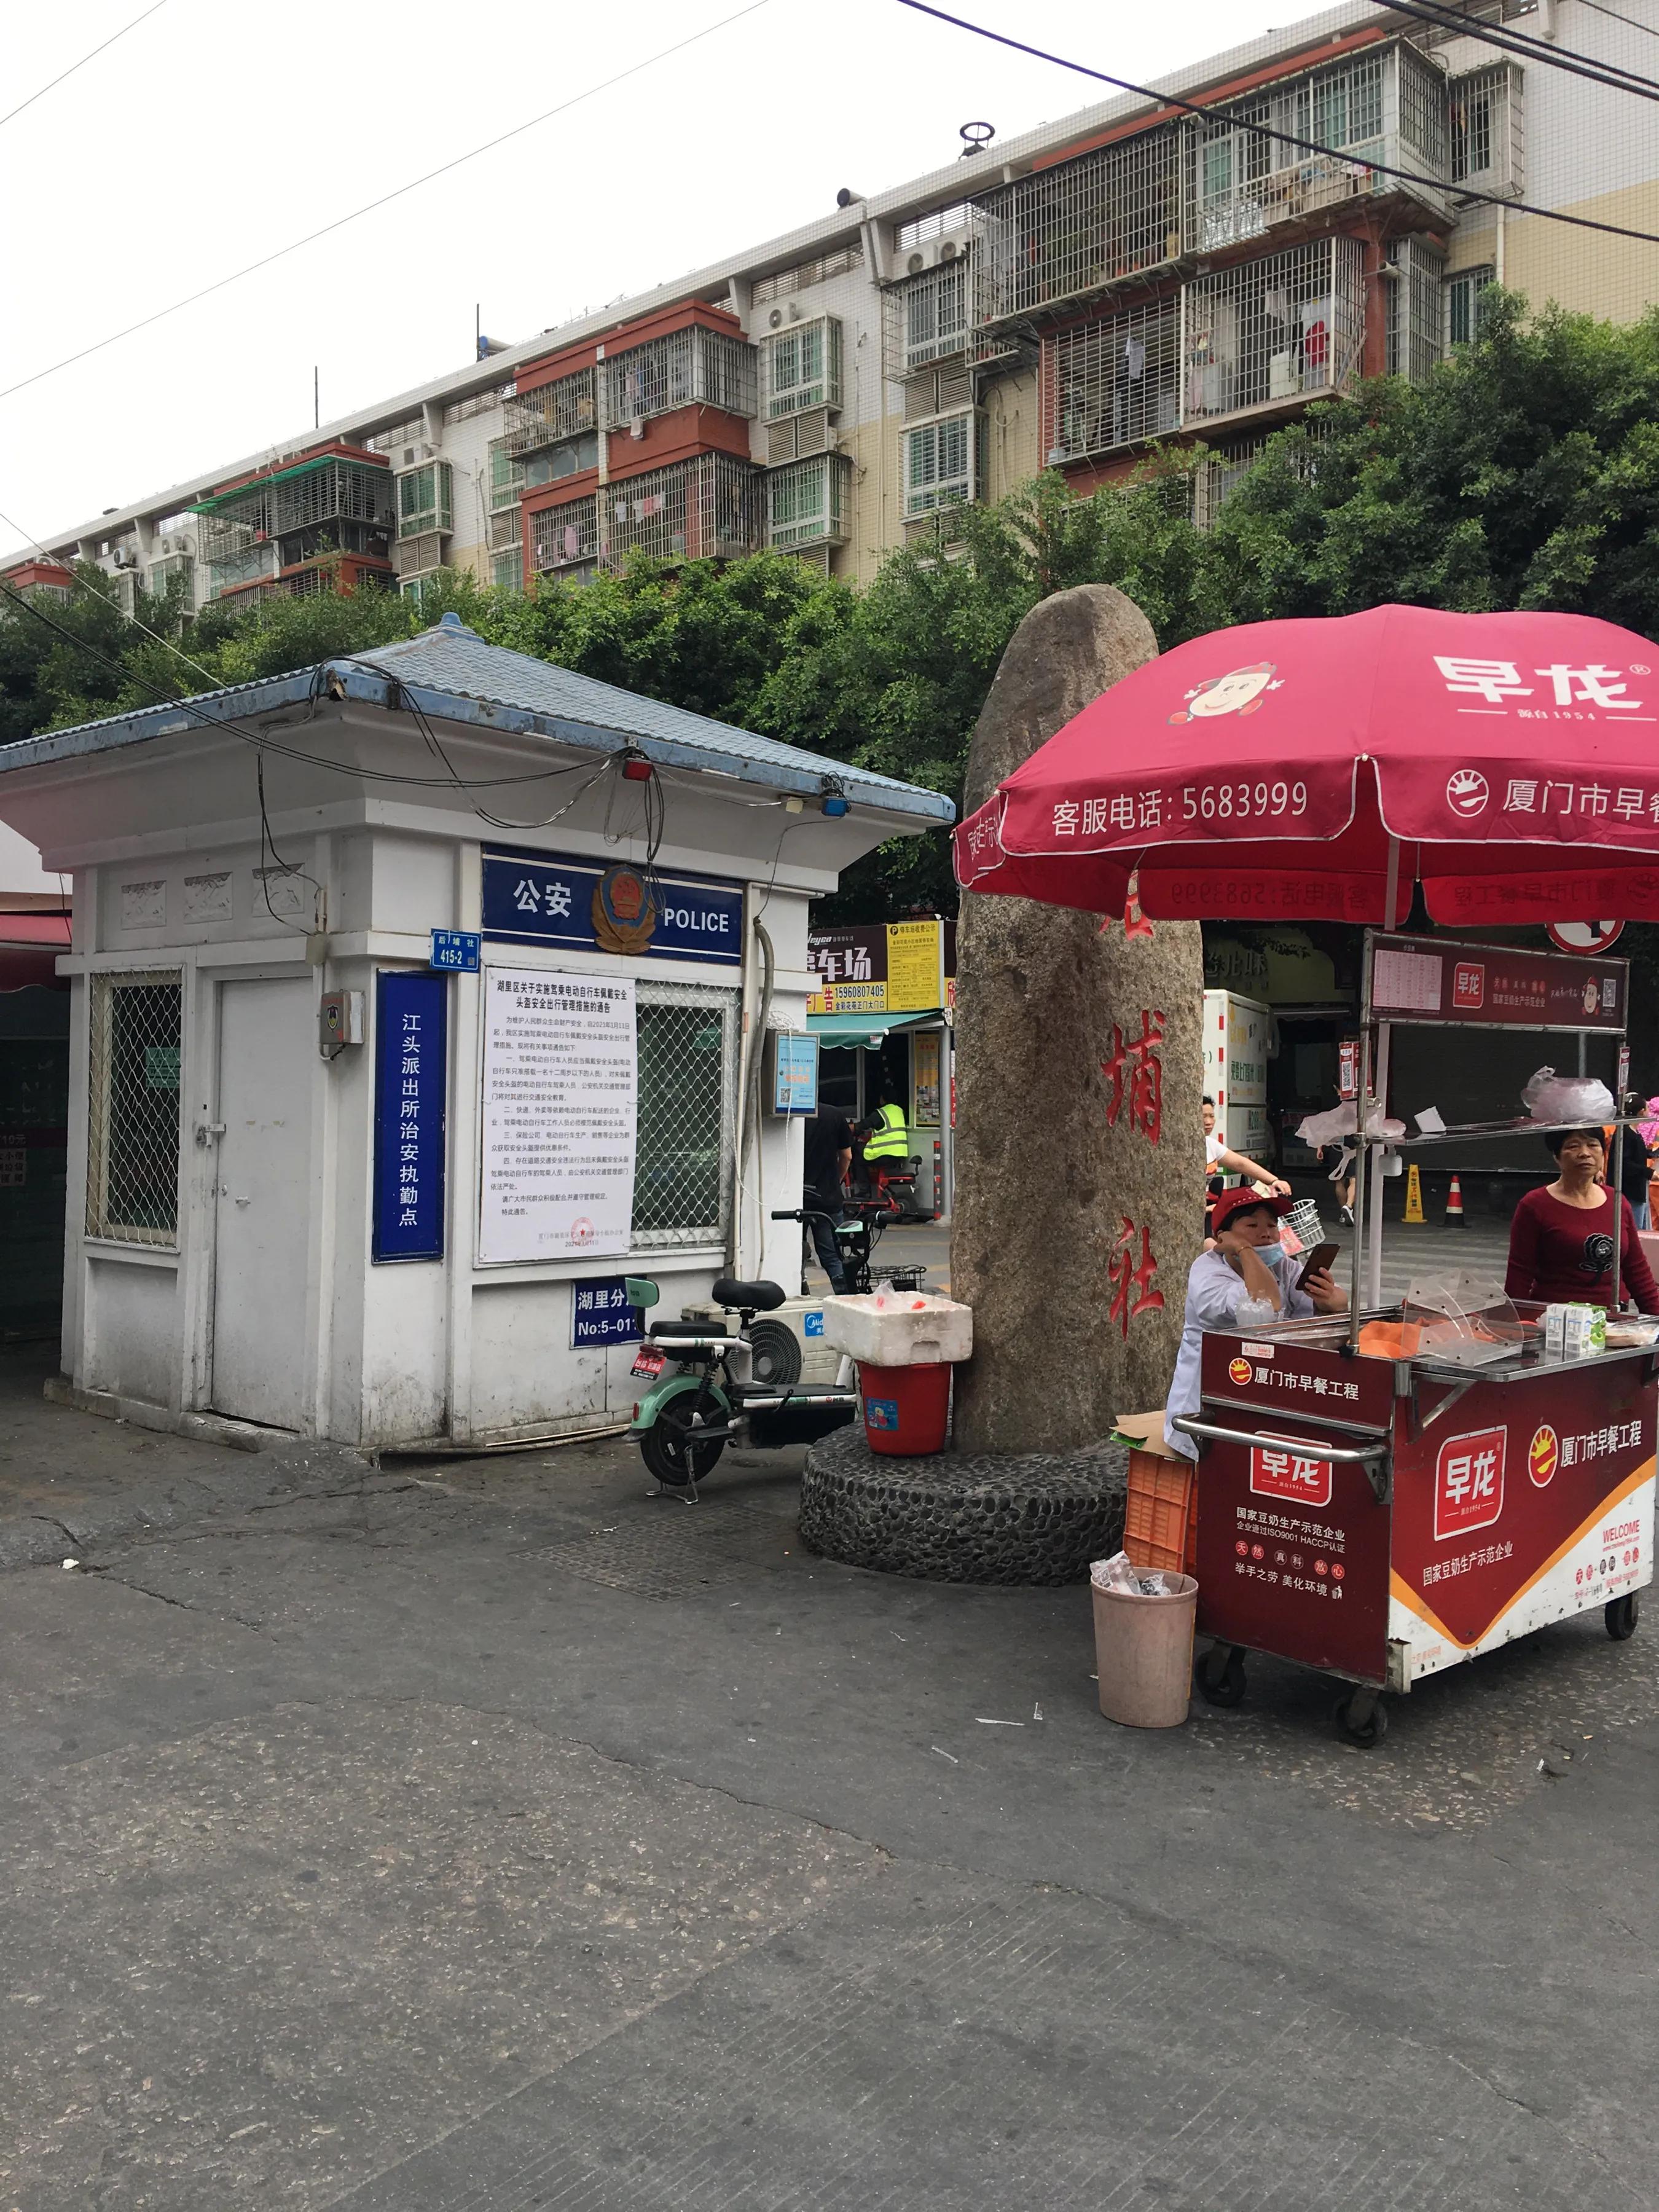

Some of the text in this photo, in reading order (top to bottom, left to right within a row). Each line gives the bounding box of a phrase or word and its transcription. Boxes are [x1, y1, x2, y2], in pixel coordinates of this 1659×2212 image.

[1433, 656, 1644, 708] 早龙
[513, 879, 572, 918] 公安
[664, 908, 729, 933] POLICE
[439, 936, 474, 947] 后埔社
[441, 949, 462, 964] 415-2
[497, 980, 627, 1000] 湖里区关于实施驾乘电动自行车佩戴安全
[835, 985, 884, 998] 15960807405
[516, 996, 611, 1013] 头盔安全出行管理措施的通告
[399, 1014, 422, 1226] 江头派出所治安执勤点
[578, 1288, 629, 1309] 湖里分
[579, 1318, 637, 1336] No:5-01
[1255, 1367, 1359, 1400] 厦门市早餐工程
[1561, 1419, 1642, 1468] 厦门市早餐工程
[1445, 1449, 1496, 1505] 早龙
[1236, 1507, 1346, 1542] 国家豆奶生产示范企业
[1602, 1520, 1640, 1543] WELCOME
[1300, 1536, 1346, 1554] HACCP认证
[1423, 1540, 1513, 1586] 国家豆奶生产示范企业
[1235, 1562, 1328, 1596] 举手之劳 美化环境
